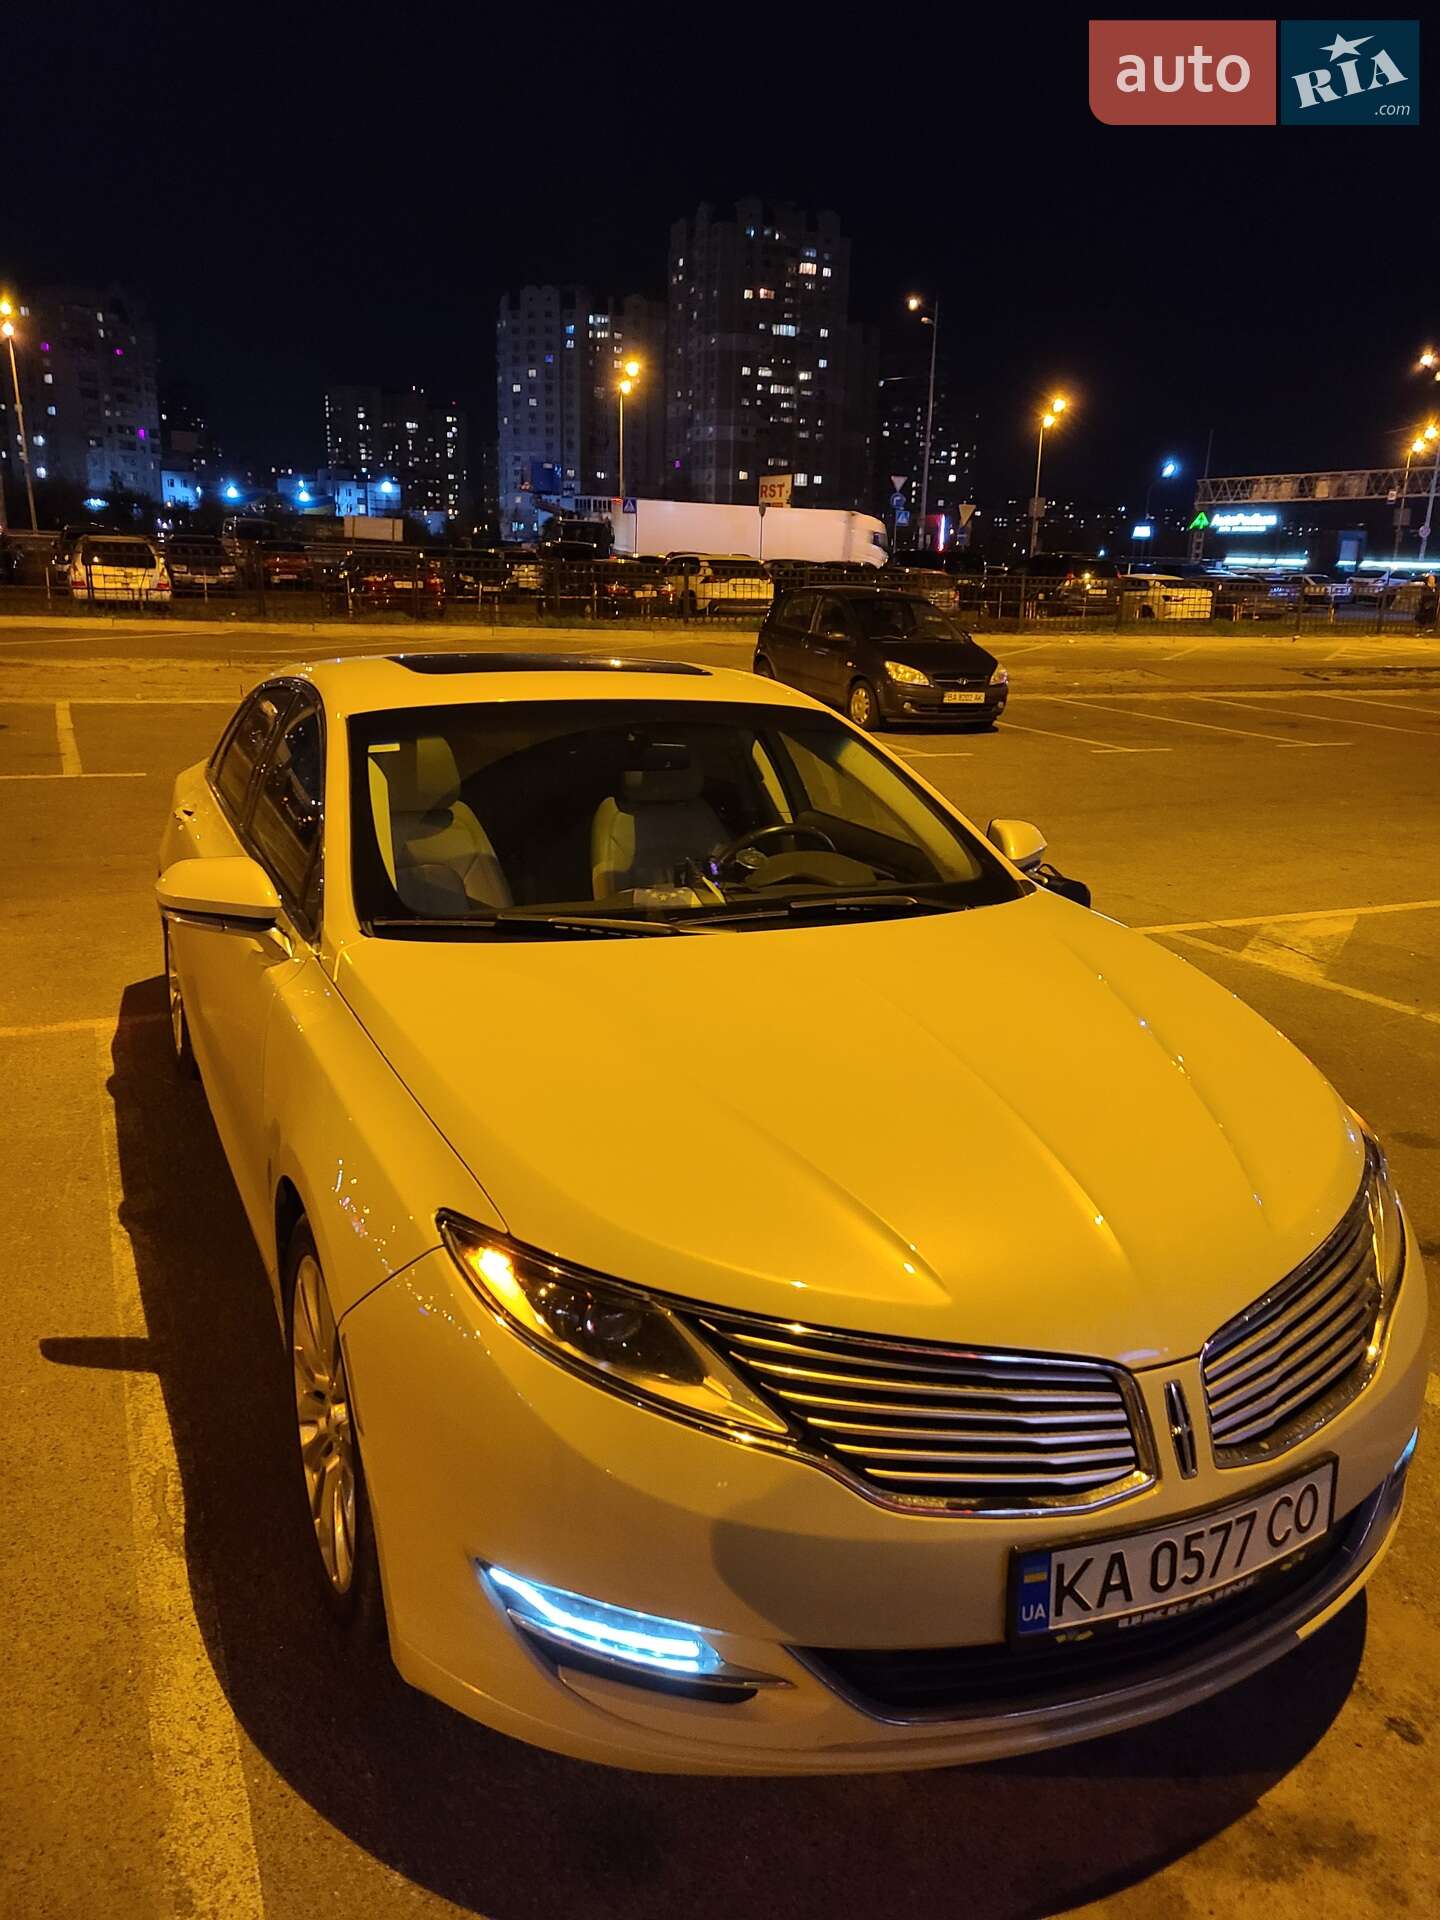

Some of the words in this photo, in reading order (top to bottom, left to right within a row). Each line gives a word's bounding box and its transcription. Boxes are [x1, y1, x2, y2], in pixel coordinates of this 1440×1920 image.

[1054, 1552, 1133, 1617] KA
[1150, 1509, 1258, 1593] 0577
[1266, 1483, 1319, 1548] CO
[1022, 1604, 1046, 1622] UA
